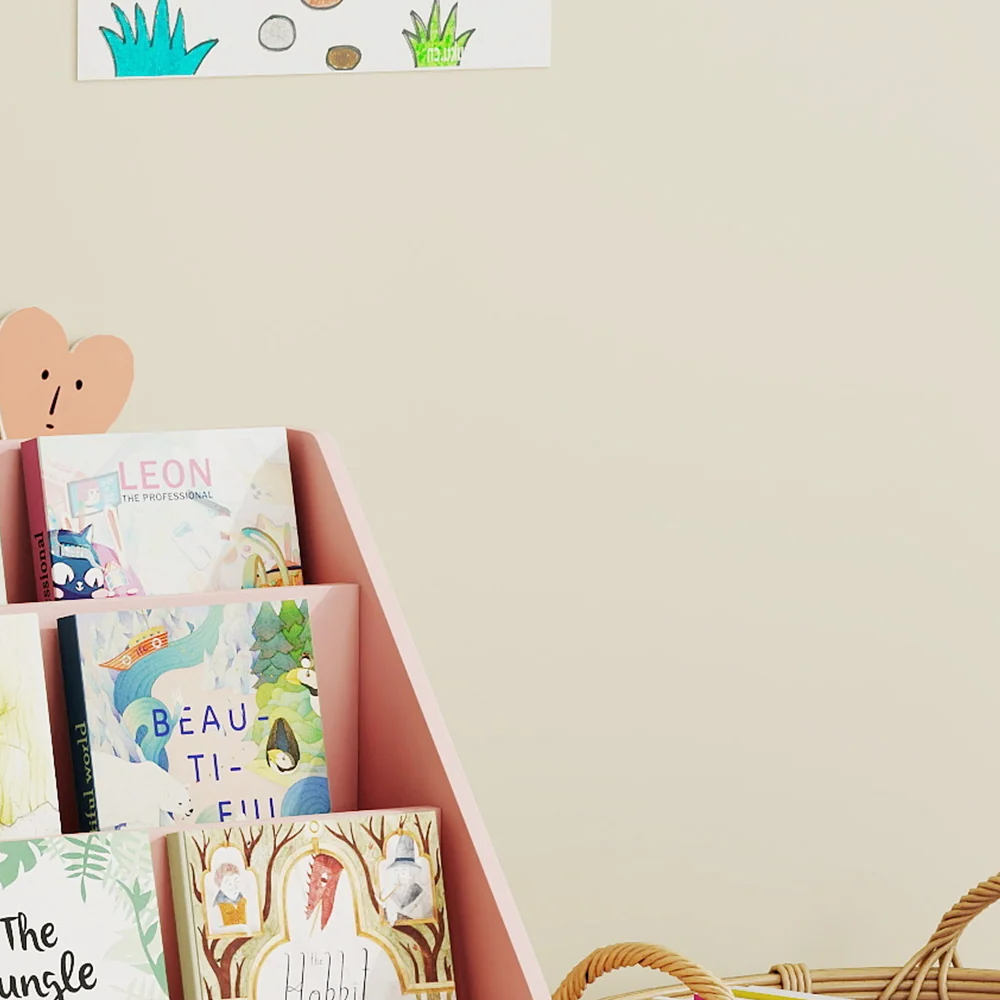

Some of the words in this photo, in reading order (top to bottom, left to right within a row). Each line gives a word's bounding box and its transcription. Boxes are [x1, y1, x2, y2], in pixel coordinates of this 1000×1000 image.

[118, 457, 213, 491] LEON
[122, 494, 141, 503] THE
[143, 490, 214, 503] PROFESSIONAL
[75, 721, 94, 785] world
[187, 753, 242, 783] TI-
[310, 954, 324, 967] the
